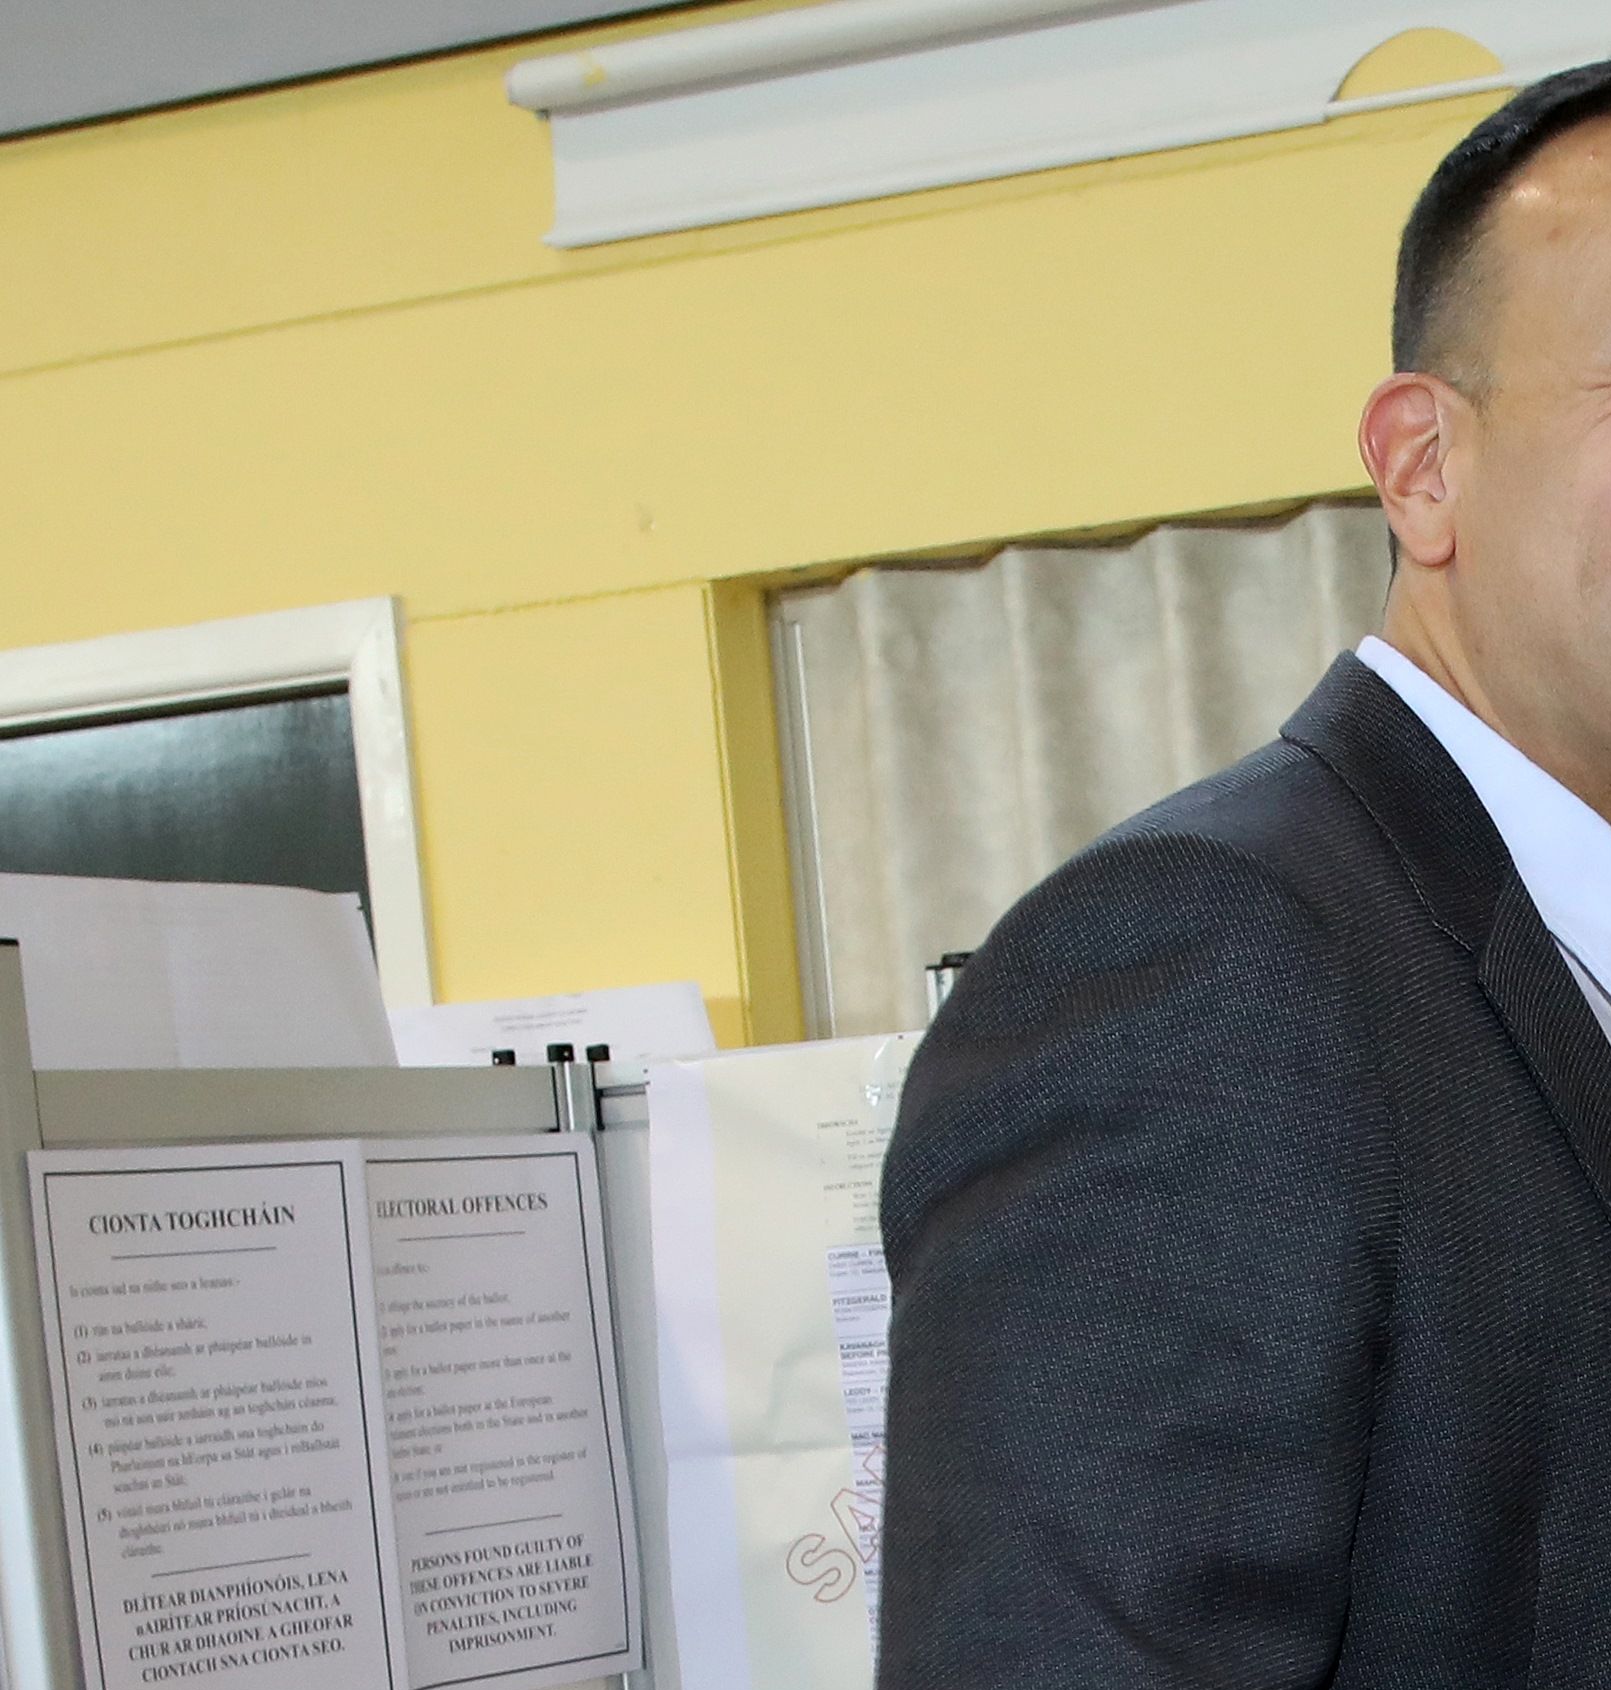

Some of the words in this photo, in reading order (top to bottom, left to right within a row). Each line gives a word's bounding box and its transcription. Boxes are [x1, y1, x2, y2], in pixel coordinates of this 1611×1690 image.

[89, 1210, 161, 1234] CIONTA
[168, 1202, 296, 1230] TOGHCHÁIN
[462, 1193, 548, 1213] OFFENCES
[411, 1552, 462, 1572] PERSONS
[465, 1546, 512, 1564] FOUND
[514, 1536, 565, 1555] GUILTY
[566, 1534, 585, 1548] OF
[442, 1567, 514, 1590] OFFENCES
[517, 1563, 543, 1577] ARE
[546, 1554, 593, 1573] LIABLE
[123, 1589, 186, 1614] DLÍTEAR
[191, 1575, 305, 1604] DIANPHÍONÓIS,
[308, 1571, 349, 1587] LENA
[429, 1588, 514, 1613] CONVICTION
[518, 1584, 536, 1598] TO
[539, 1577, 589, 1594] SEVERE
[136, 1610, 214, 1636] nAIRÍTEAR
[328, 1594, 341, 1606] A
[427, 1613, 500, 1635] PENALTIES,
[503, 1599, 577, 1623] INCLUDING
[129, 1640, 170, 1661] CHUR
[174, 1639, 192, 1653] AR
[196, 1628, 265, 1650] DHAOINE
[268, 1627, 278, 1639] A
[280, 1613, 354, 1636] GHEOFAR
[449, 1624, 557, 1653] IMPRISONMENT.
[142, 1657, 218, 1683] CIONTACH
[220, 1653, 249, 1668] SNA
[252, 1647, 309, 1665] CIONTA
[312, 1639, 345, 1654] SEO.
